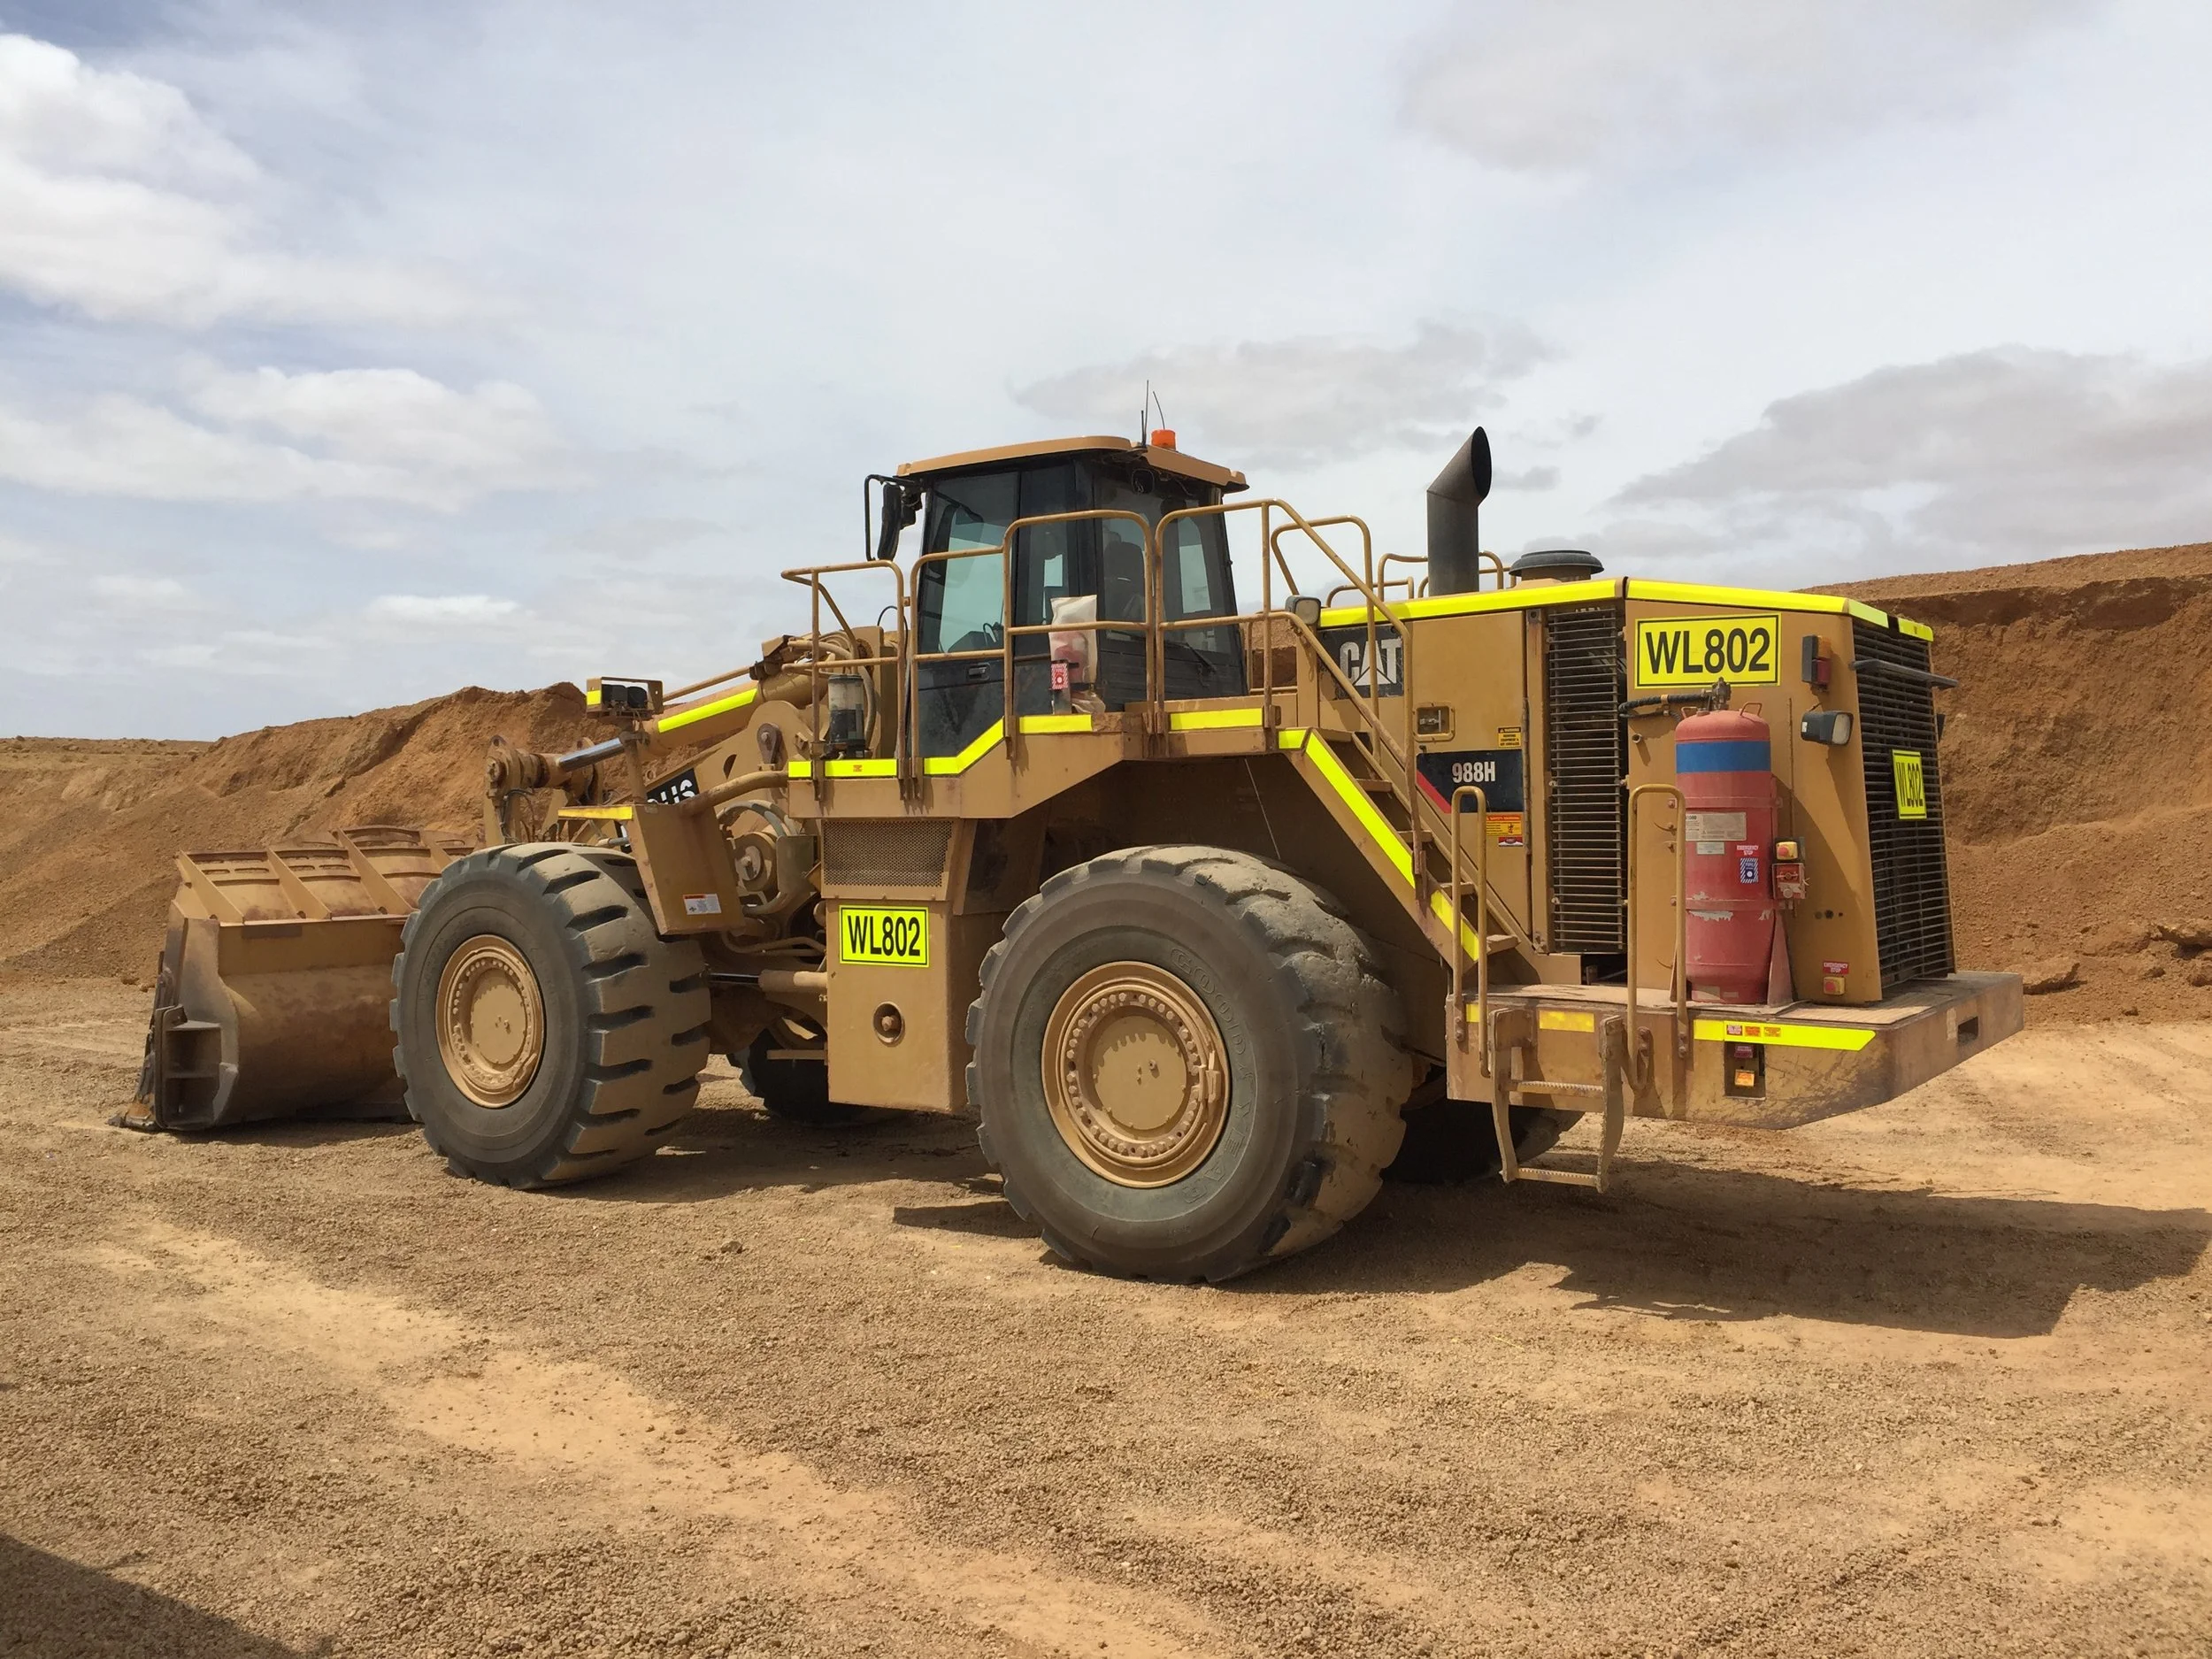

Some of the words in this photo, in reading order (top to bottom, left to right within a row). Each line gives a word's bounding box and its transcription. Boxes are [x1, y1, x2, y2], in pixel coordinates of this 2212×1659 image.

[1339, 636, 1402, 687] CAT
[1645, 626, 1770, 675] WL802
[1451, 761, 1496, 784] 988H
[1895, 762, 1924, 809] WL802
[847, 914, 921, 957] WL802
[1170, 947, 1254, 1204] GOODYEAR
